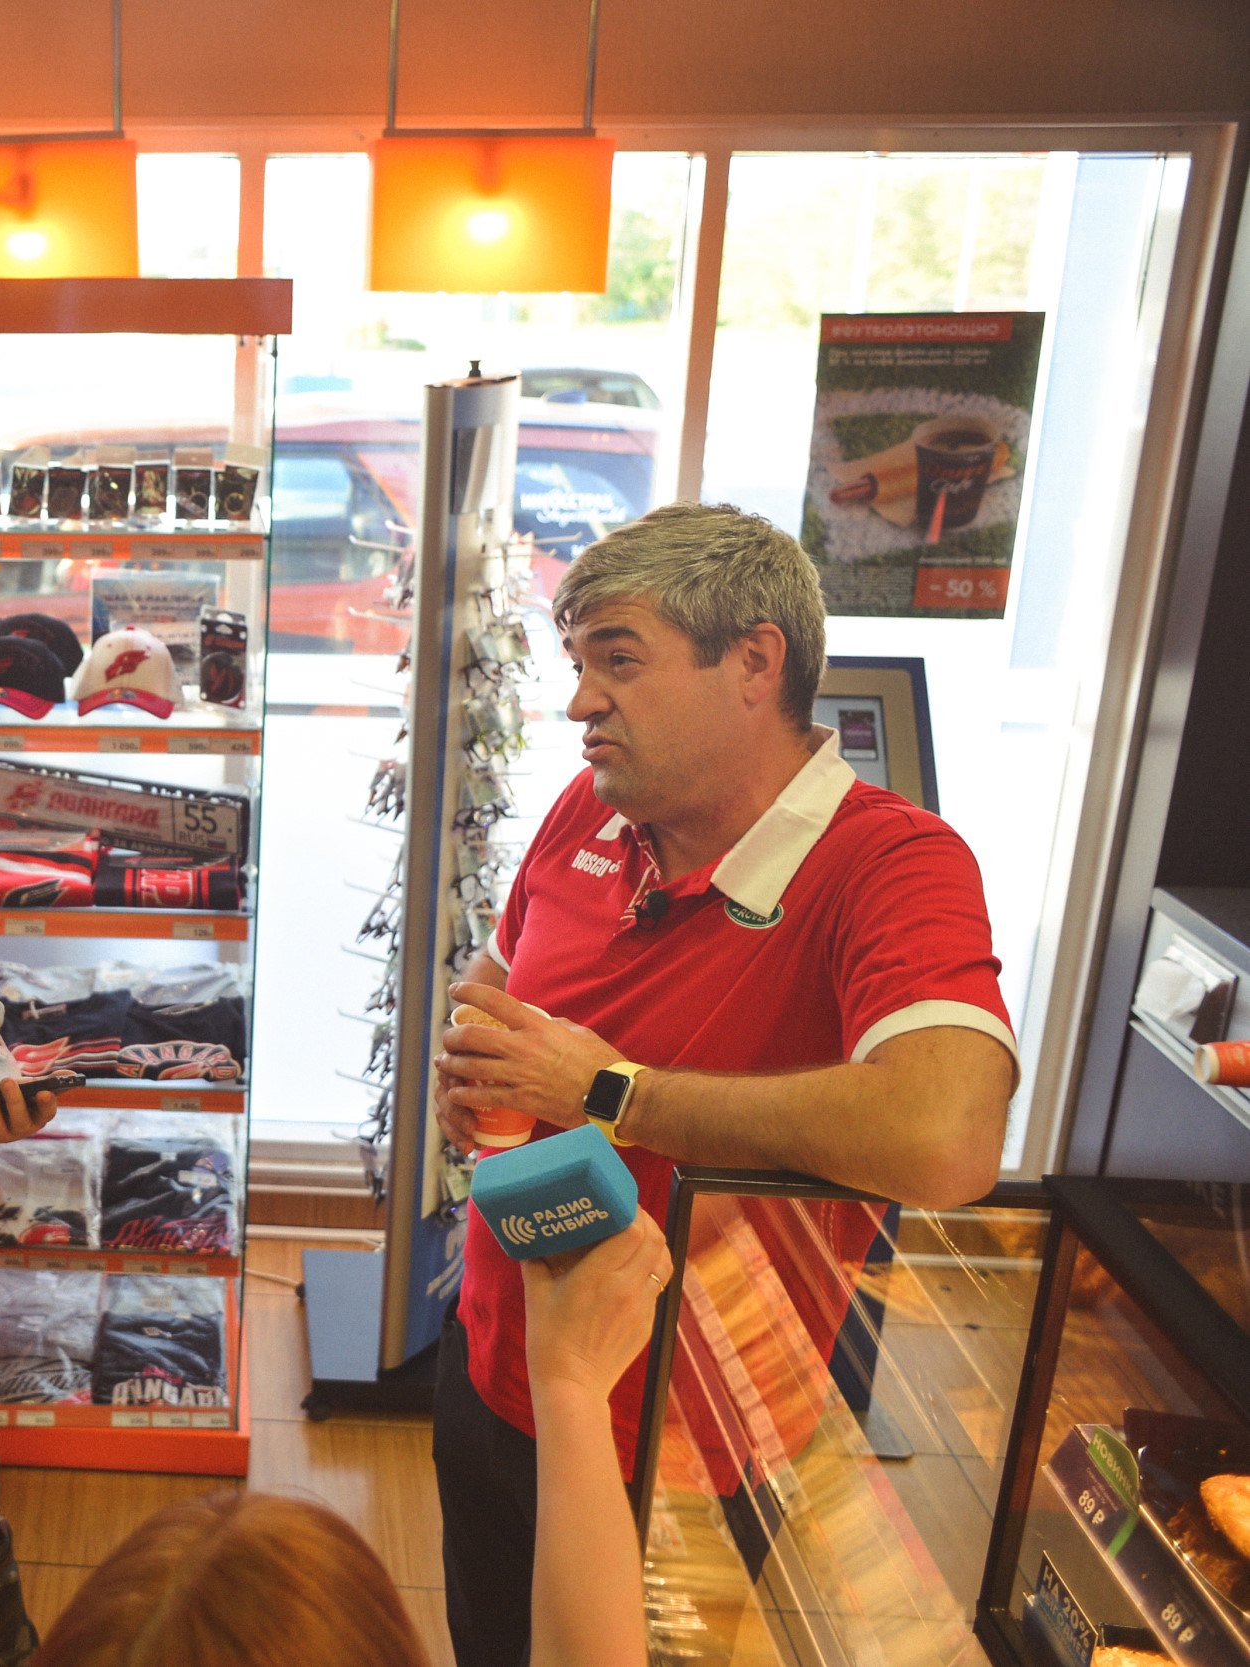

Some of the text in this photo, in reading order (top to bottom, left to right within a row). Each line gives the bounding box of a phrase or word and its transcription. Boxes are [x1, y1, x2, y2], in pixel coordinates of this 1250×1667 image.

[945, 578, 974, 598] 50
[978, 578, 999, 599] %
[47, 792, 160, 829] АВАНГАРД
[183, 802, 218, 834] 55
[178, 831, 208, 847] RUS
[571, 848, 612, 878] BOSCO
[116, 1043, 237, 1079] AVANGARD
[533, 1197, 592, 1224] РАДИО
[540, 1208, 610, 1238] СИБИРЬ
[1078, 1489, 1096, 1514] 89
[1042, 1564, 1090, 1649] НА 20%
[1160, 1601, 1182, 1630] 89
